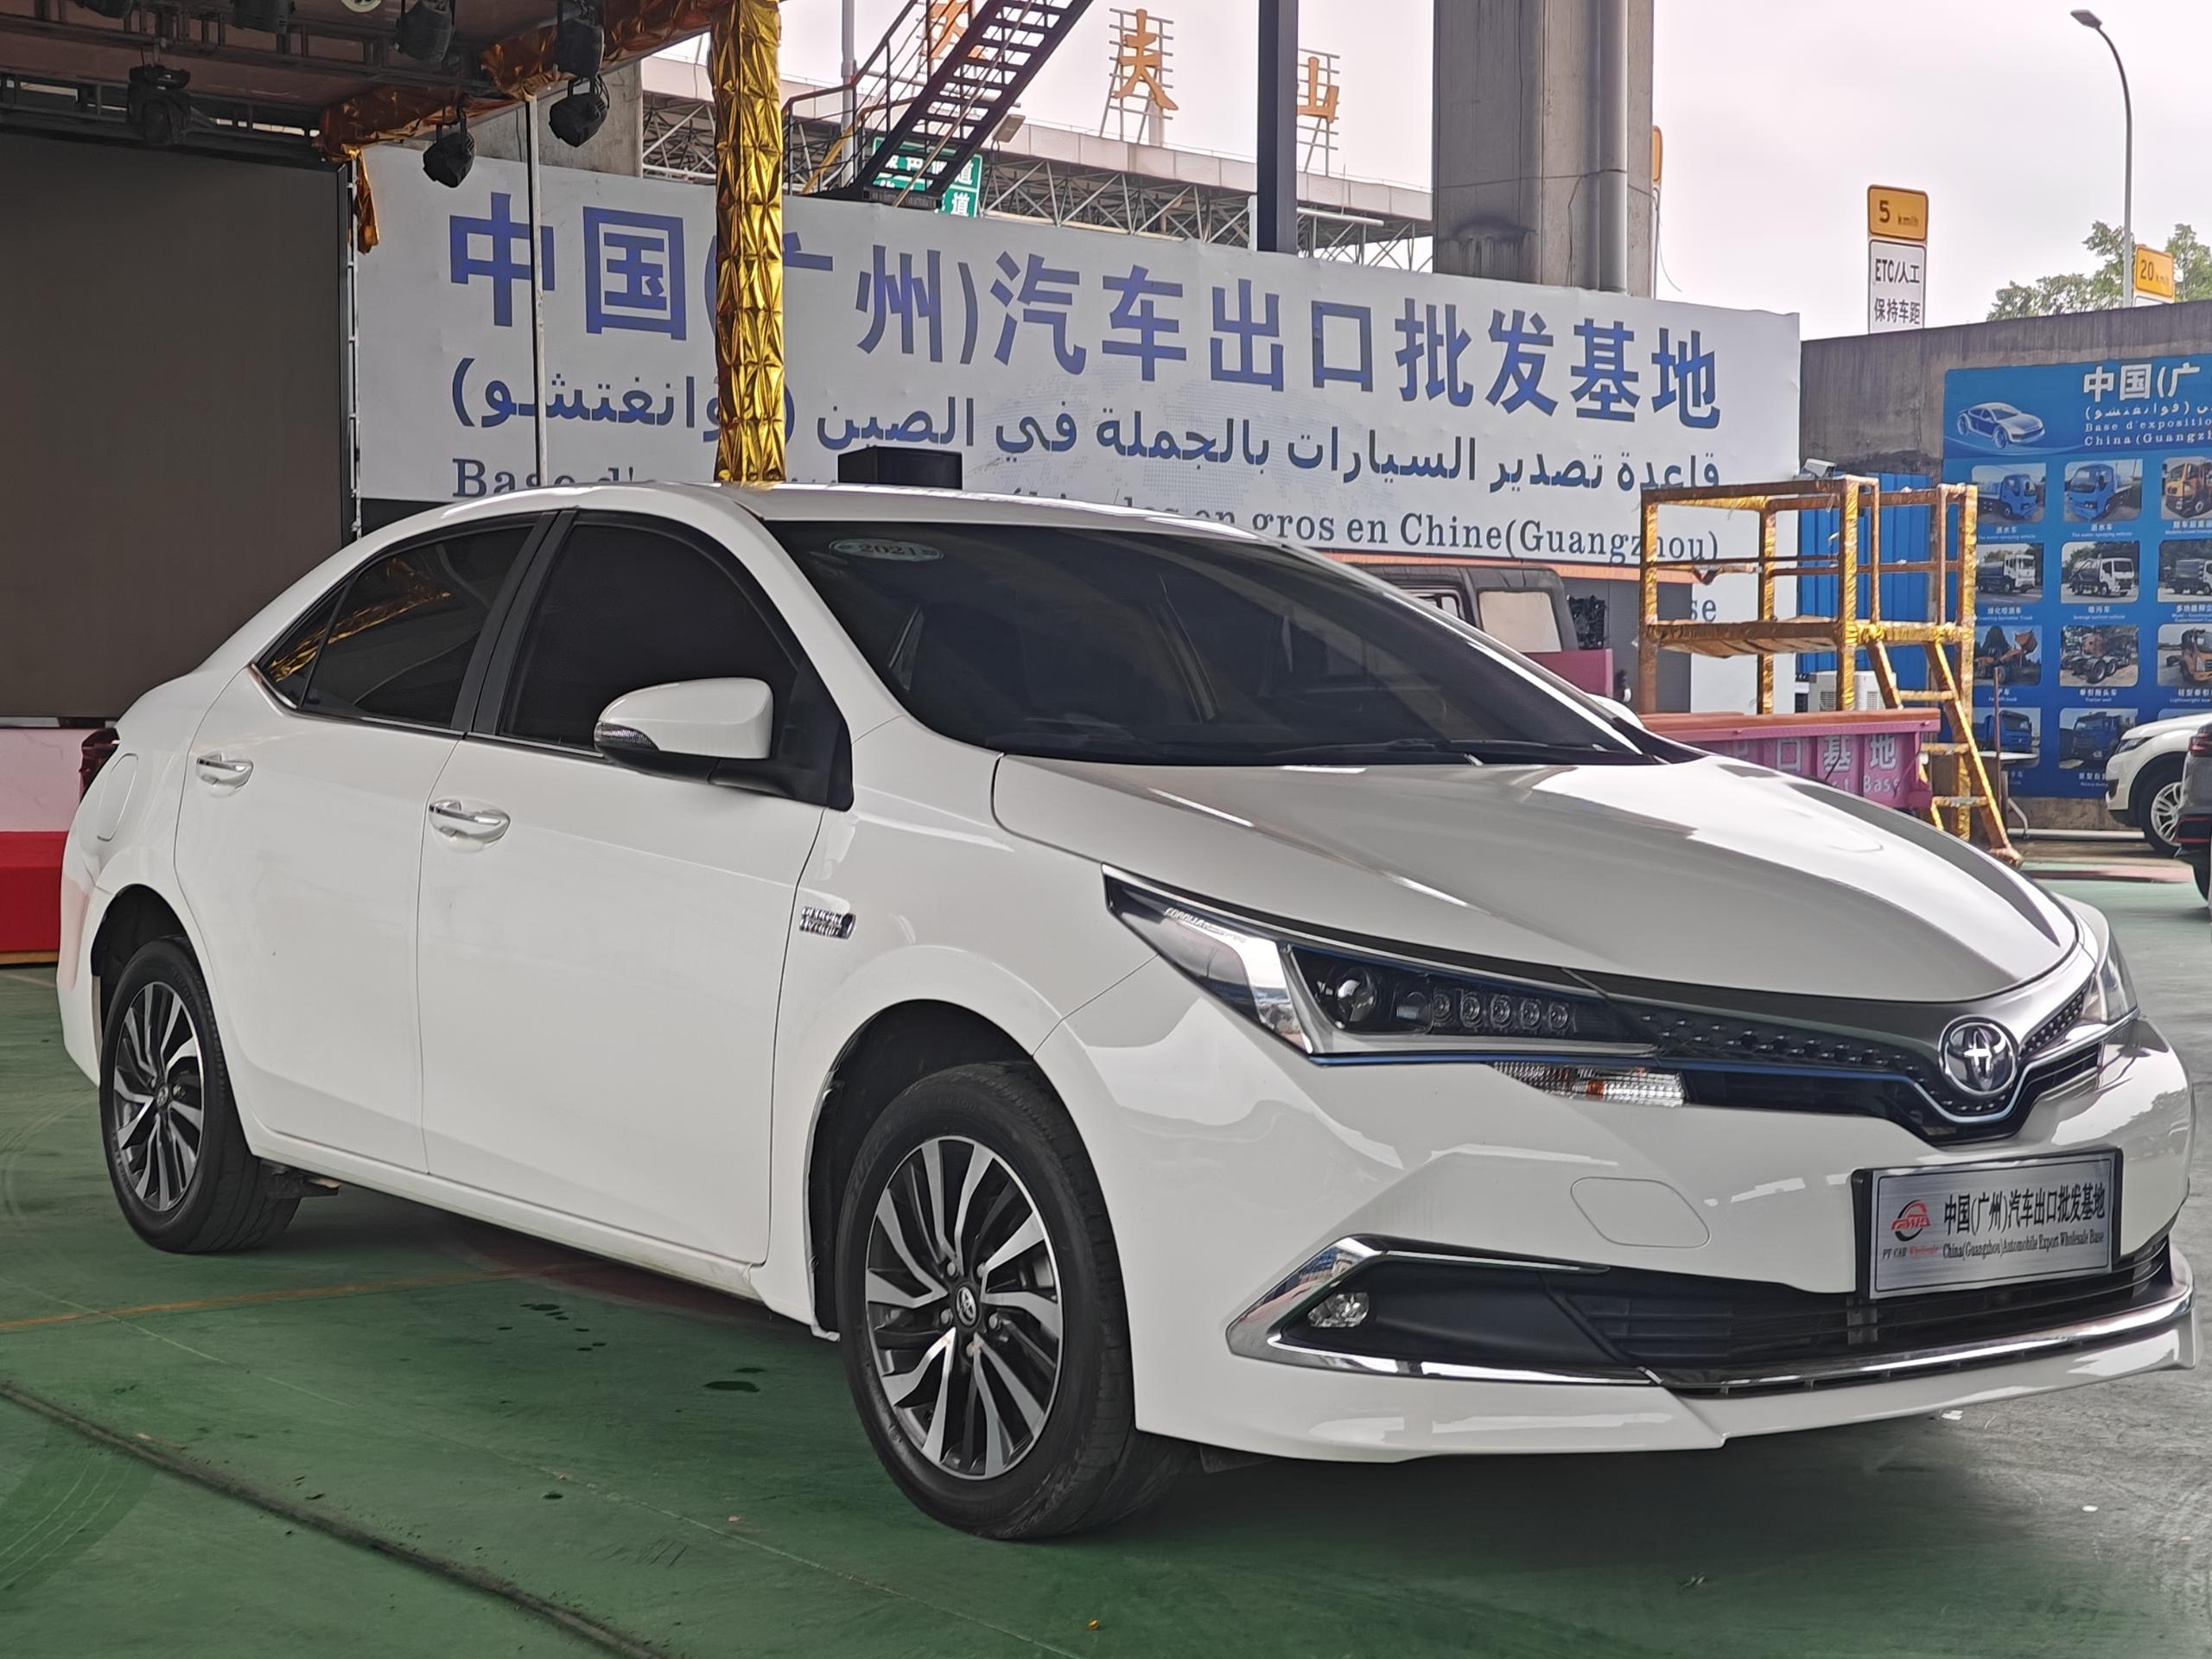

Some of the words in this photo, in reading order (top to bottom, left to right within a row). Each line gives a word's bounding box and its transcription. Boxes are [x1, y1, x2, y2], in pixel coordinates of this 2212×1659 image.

[1879, 200, 1891, 223] 5
[1875, 258, 1920, 283] ETC/人工
[2140, 259, 2154, 281] 20
[1874, 297, 1921, 324] 保持车距
[451, 358, 795, 445] (وانغتشو)
[817, 397, 975, 451] الصين
[995, 400, 1077, 463] في
[1096, 407, 1270, 471] بالجملة
[1287, 426, 1477, 484] السيارات
[1490, 454, 1604, 493] تصدير
[1346, 518, 1389, 543] en
[1944, 1182, 2106, 1236] 中国(广州)汽车出口批发基地
[2039, 1233, 2059, 1252] Export
[2060, 1229, 2088, 1247] Wholesale
[2089, 1228, 2104, 1243] Base
